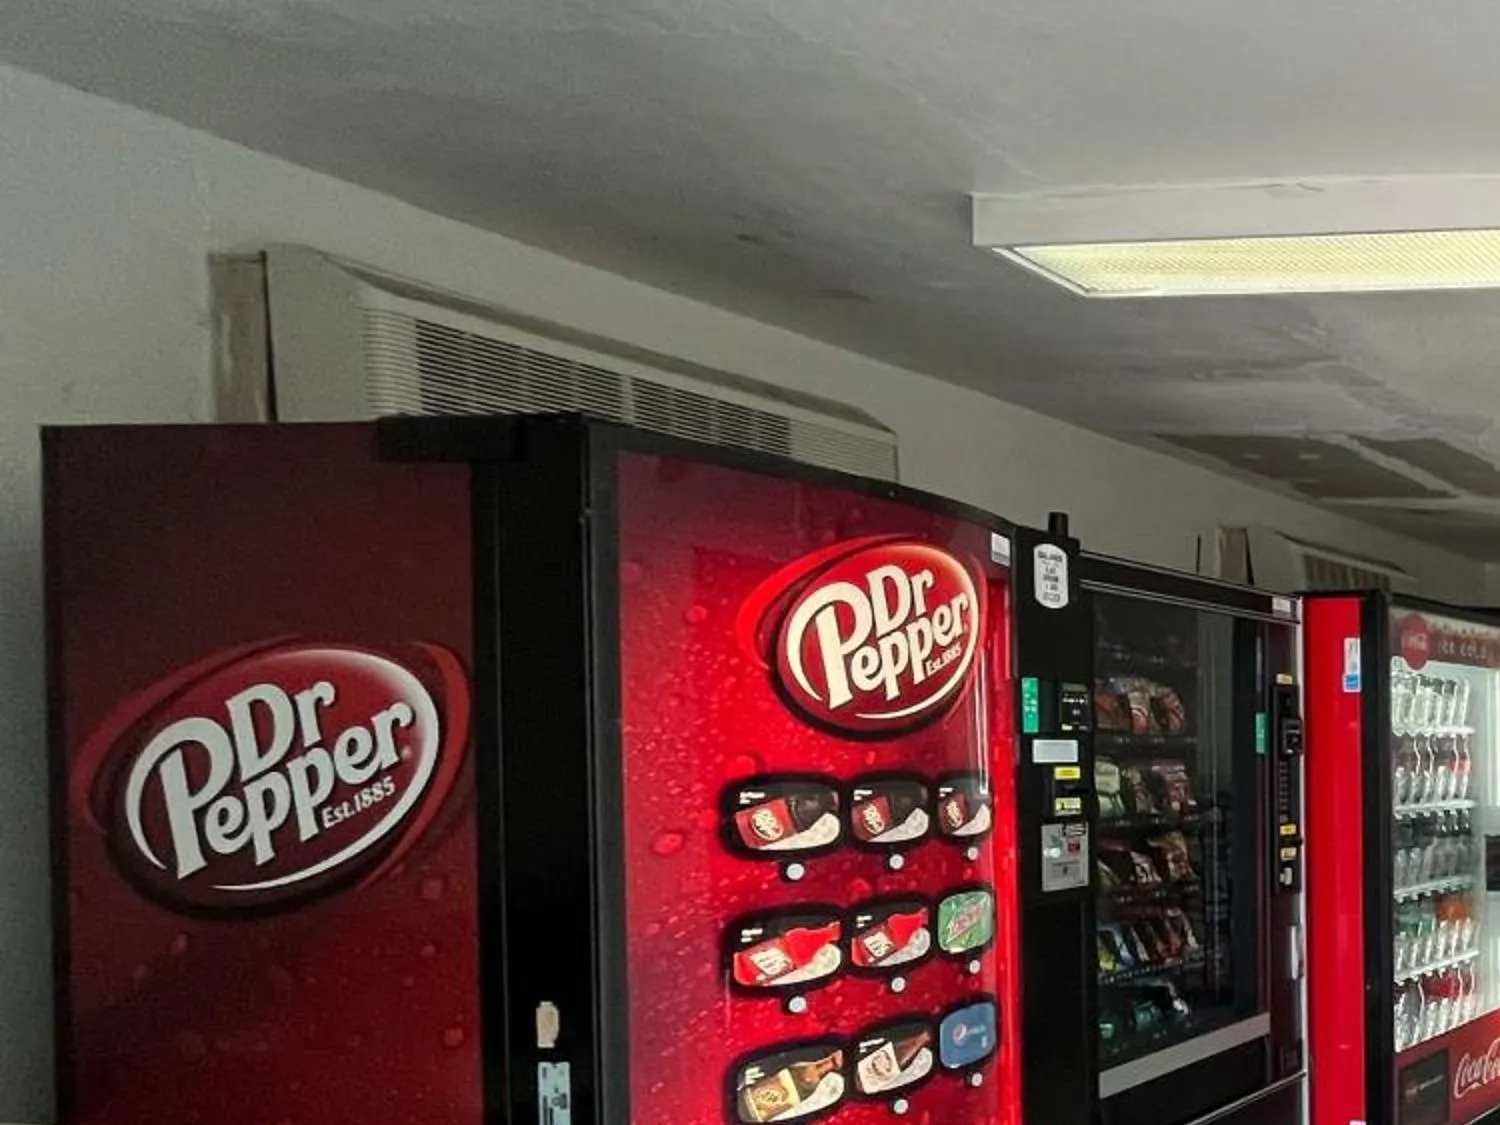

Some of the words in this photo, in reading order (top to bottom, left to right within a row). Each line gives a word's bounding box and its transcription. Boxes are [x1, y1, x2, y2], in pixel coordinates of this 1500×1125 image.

[787, 581, 969, 710] Pepper
[865, 565, 934, 639] Dr
[225, 681, 335, 783] Dr
[126, 702, 413, 880] Pepper
